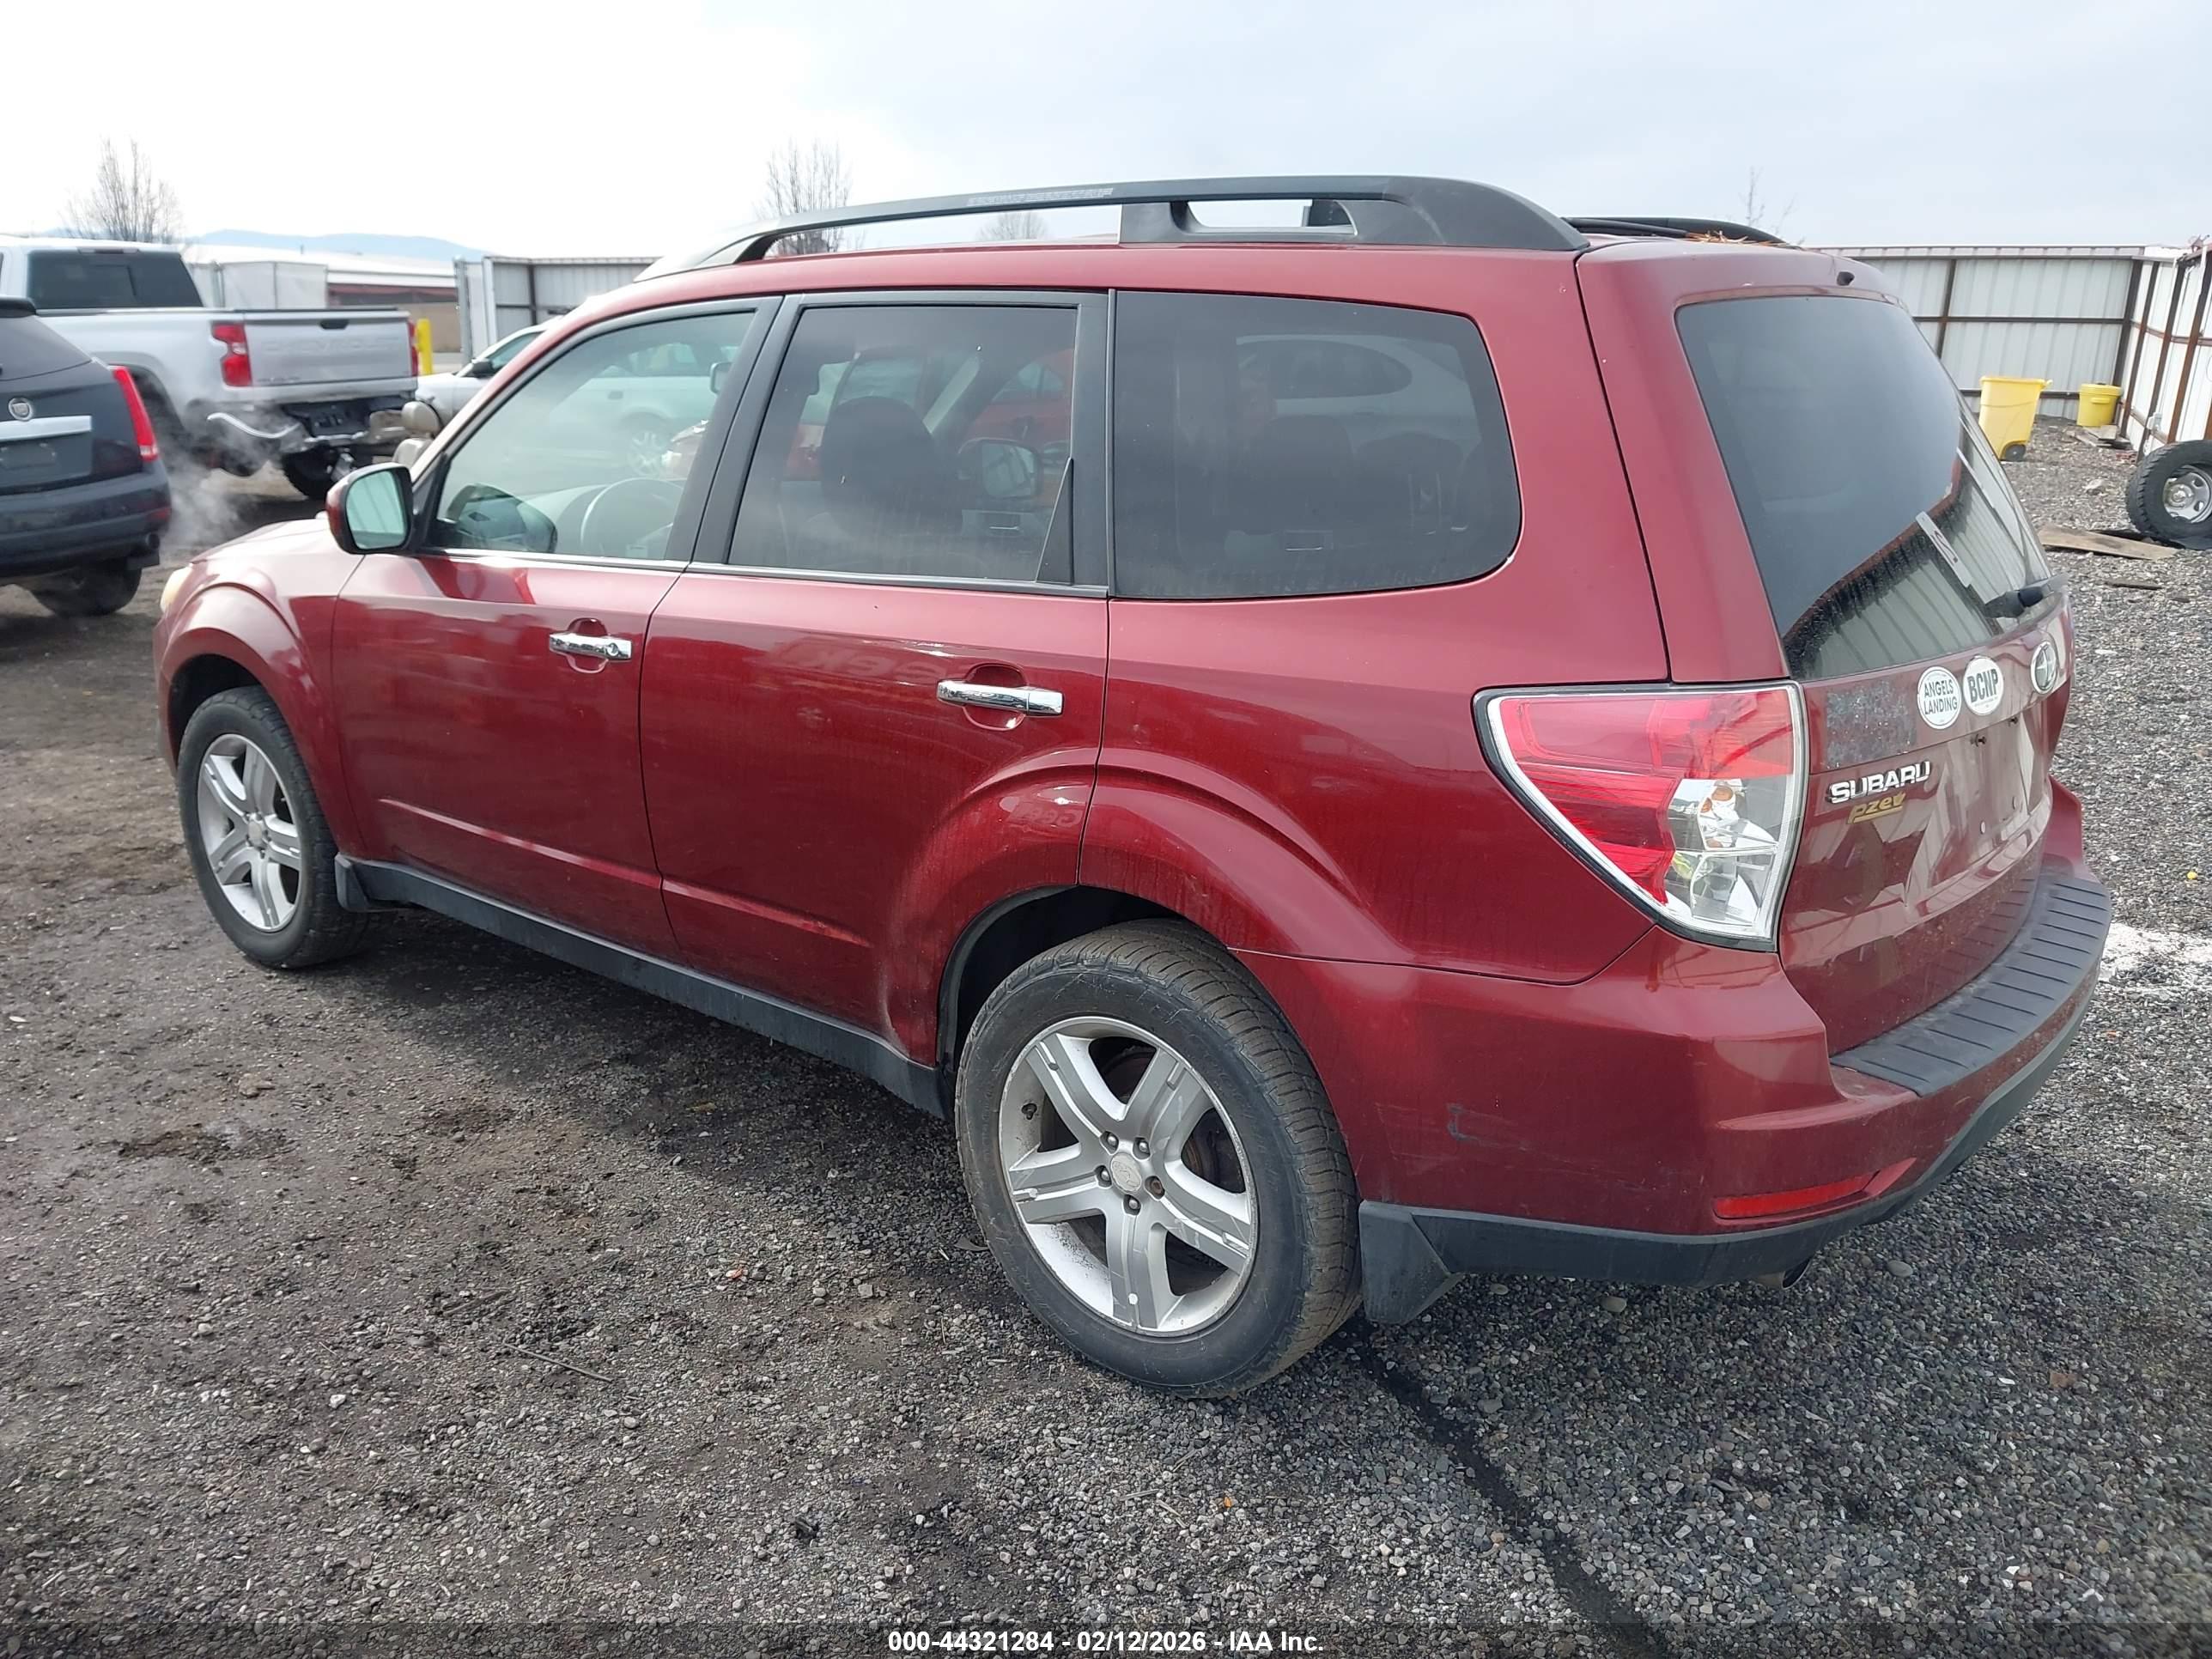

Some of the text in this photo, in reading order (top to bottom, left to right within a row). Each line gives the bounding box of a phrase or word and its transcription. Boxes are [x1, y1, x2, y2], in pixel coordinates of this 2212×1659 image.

[1924, 678, 1954, 698] ANGELS
[1967, 668, 1999, 703] BCNP
[1924, 696, 1958, 715] LANDING
[1828, 761, 1931, 804] SUBARU
